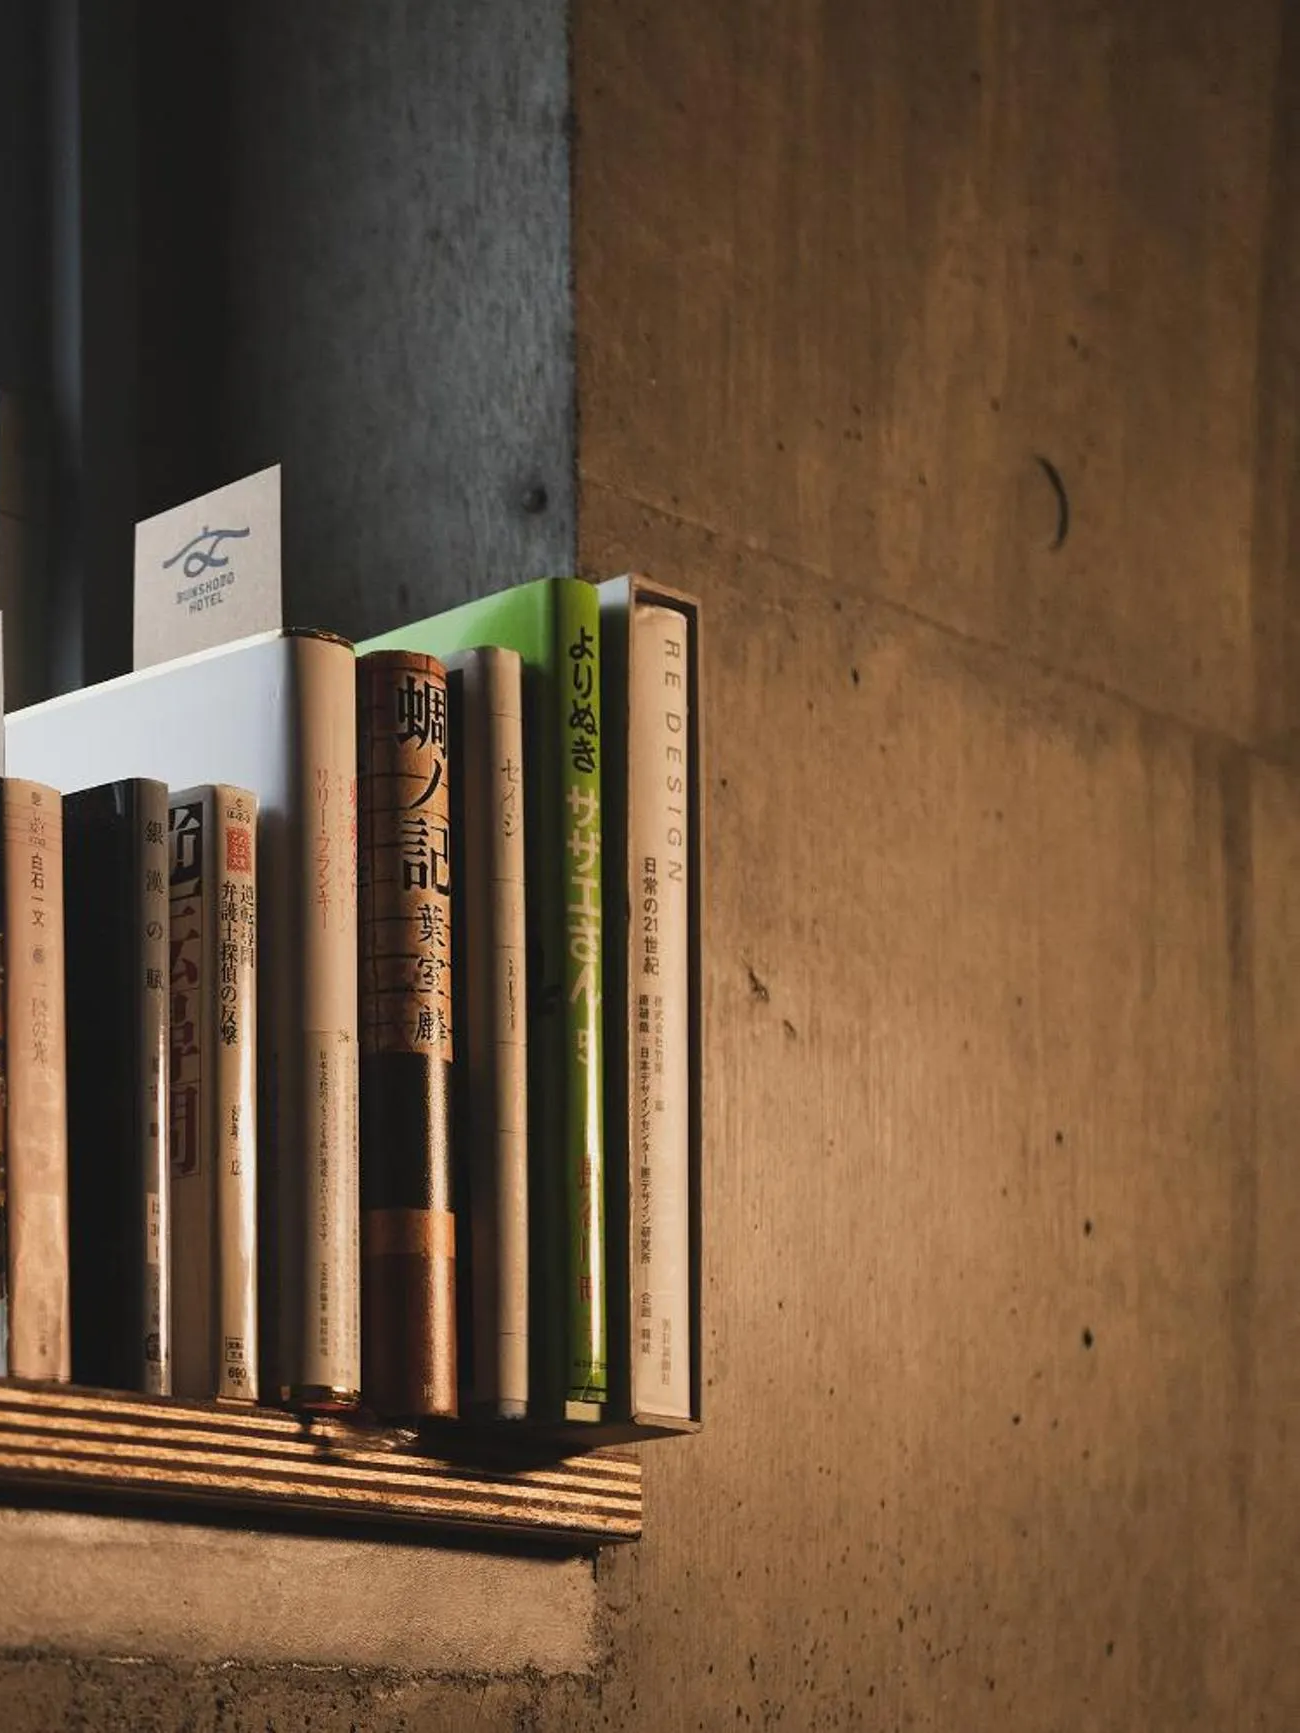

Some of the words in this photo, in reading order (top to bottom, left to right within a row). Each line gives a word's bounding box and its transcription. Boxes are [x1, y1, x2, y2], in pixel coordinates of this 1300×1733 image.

[188, 592, 224, 615] HOTEL
[569, 625, 598, 774] よりぬき
[663, 638, 682, 690] RE
[665, 711, 683, 882] DESIGN
[30, 852, 46, 928] 白石一文
[642, 857, 660, 976] 日常の21世紀
[415, 903, 449, 1045] 葉室麟
